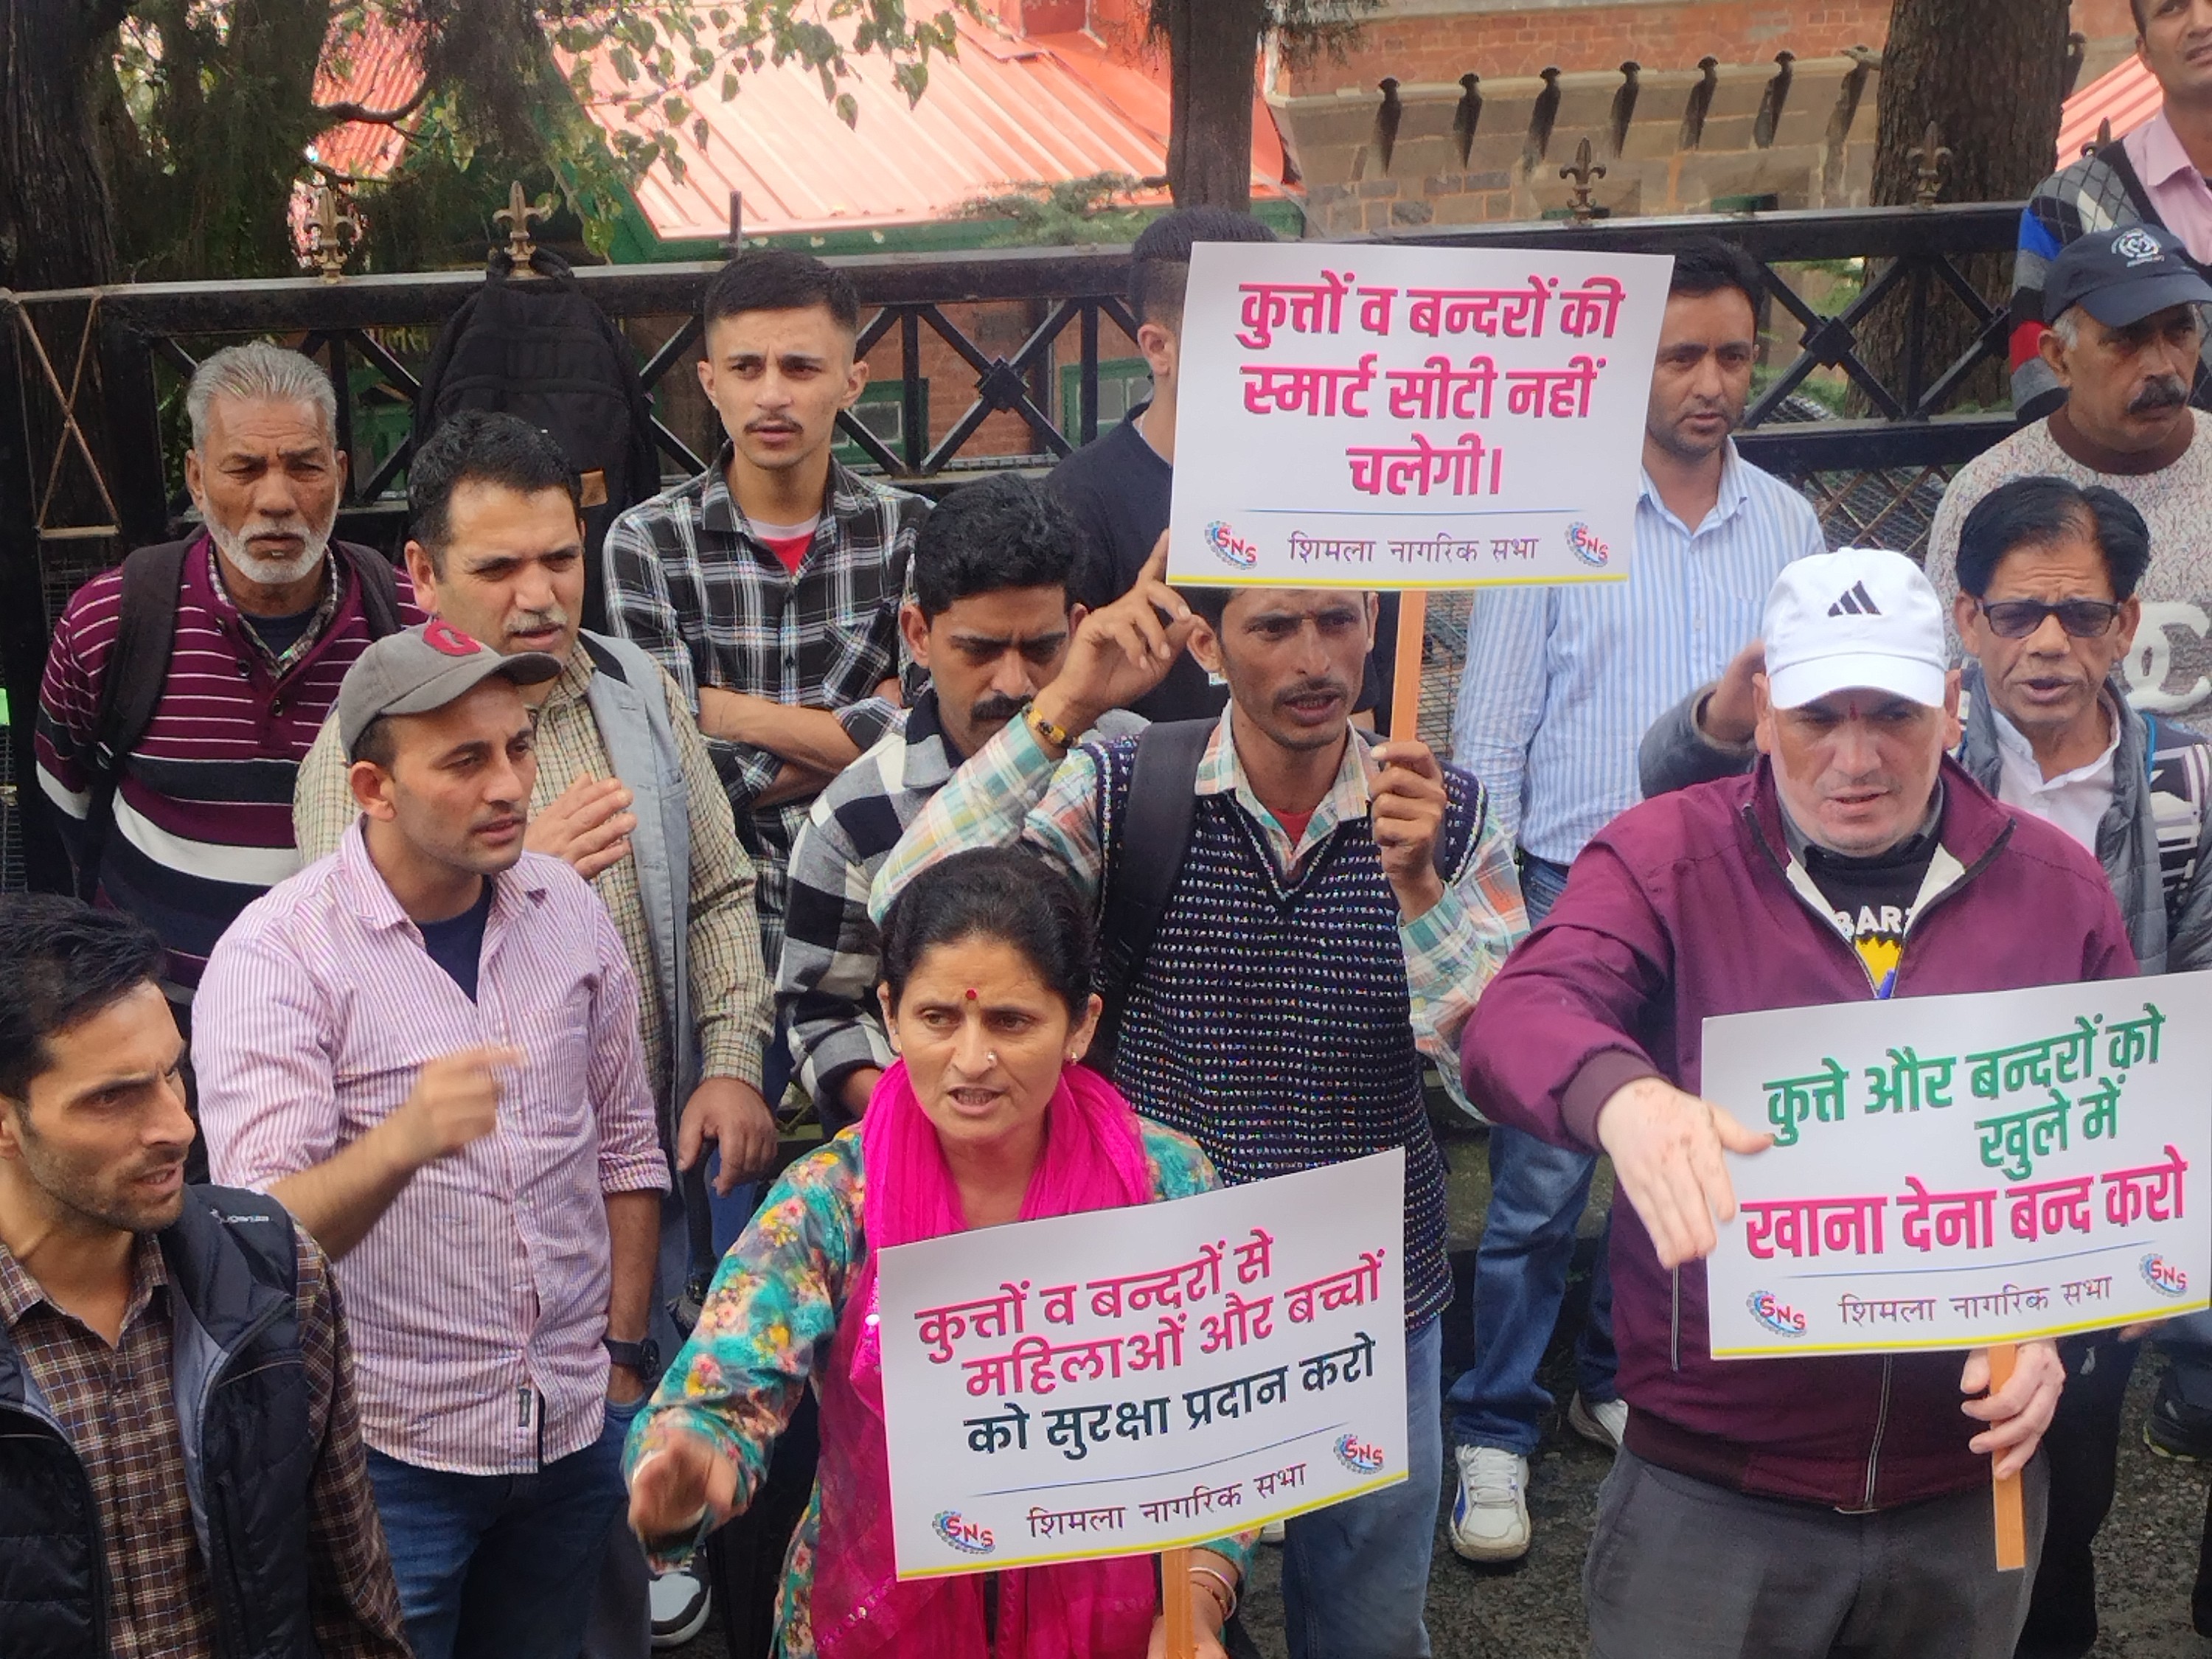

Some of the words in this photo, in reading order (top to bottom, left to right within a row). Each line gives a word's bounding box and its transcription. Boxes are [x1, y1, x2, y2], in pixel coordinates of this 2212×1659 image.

[1234, 270, 1354, 348] कुत्तों
[1357, 288, 1397, 335] व
[1407, 276, 1558, 338] बन्दरों
[1560, 276, 1626, 338] की
[1239, 353, 1377, 417] स्मार्ट
[1386, 355, 1498, 419] सीटी
[1506, 355, 1606, 418] नहीं
[1215, 528, 1257, 565] SNS
[1288, 531, 1376, 563] शिमला
[1387, 534, 1479, 563] नागरिक
[1491, 536, 1540, 562] सभा
[1575, 528, 1608, 562] SNS
[1762, 1057, 1848, 1147] कुत्ते
[1865, 1046, 1956, 1114] और
[1965, 1013, 2104, 1100] बन्दरों
[2105, 1001, 2166, 1070] को
[1975, 1089, 2071, 1181] खुले
[2079, 1076, 2126, 1140] में
[1741, 1196, 1888, 1260] खाना
[1896, 1175, 1996, 1253] देना
[2006, 1176, 2094, 1242] बन्द
[2101, 1144, 2188, 1225] करो
[914, 1280, 1031, 1366] कुत्तों
[1040, 1284, 1077, 1326] व
[1087, 1239, 1226, 1319] बन्दरों
[1234, 1228, 1273, 1284] से
[1839, 1293, 1936, 1326] शिमला
[1950, 1284, 2049, 1318] नागरिक
[2061, 1276, 2112, 1305] सभा
[2149, 1258, 2188, 1290] SNS
[961, 1312, 1188, 1397] महिलाओं
[1200, 1293, 1273, 1354] और
[1284, 1248, 1385, 1323] बच्चों
[1759, 1295, 1806, 1330] SNS
[964, 1402, 1030, 1454] को
[1042, 1397, 1170, 1461] सुरक्षा
[1182, 1366, 1288, 1430] प्रदान
[1299, 1332, 1376, 1391] करो
[1343, 1437, 1384, 1467] SNS
[946, 1514, 994, 1548] SNS
[1027, 1506, 1127, 1538] शिमला
[1139, 1484, 1242, 1524] नागरिक
[1253, 1463, 1307, 1498] सभा
